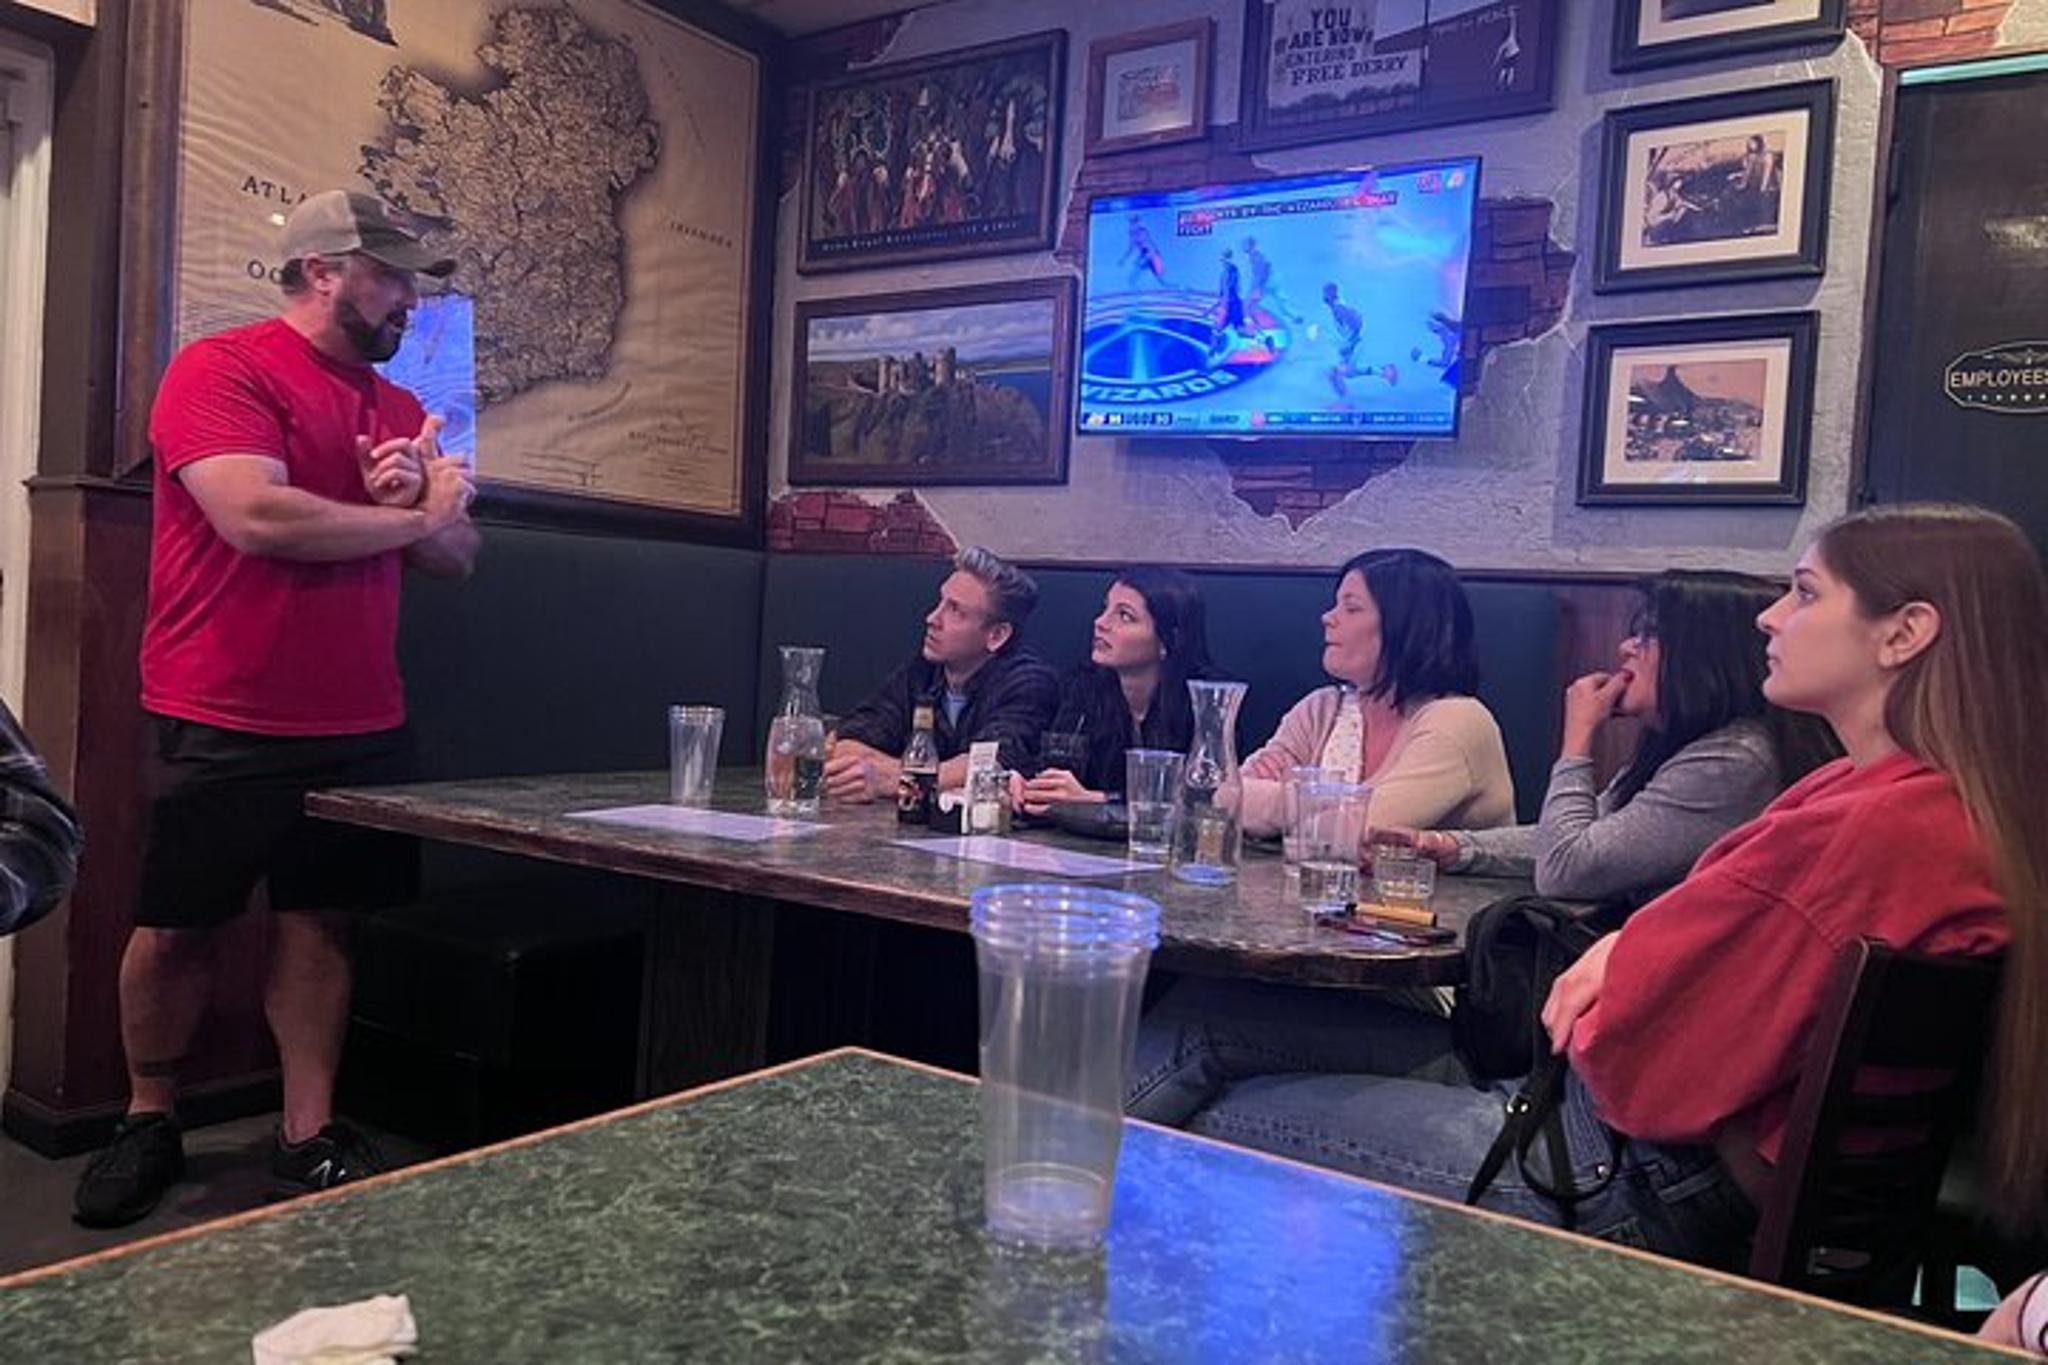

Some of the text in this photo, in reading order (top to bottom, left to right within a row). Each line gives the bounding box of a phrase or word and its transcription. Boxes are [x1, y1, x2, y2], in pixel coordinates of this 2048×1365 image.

[1310, 8, 1351, 29] YOU
[1288, 27, 1368, 50] ARE NOW
[1290, 56, 1408, 87] FREE DERRY
